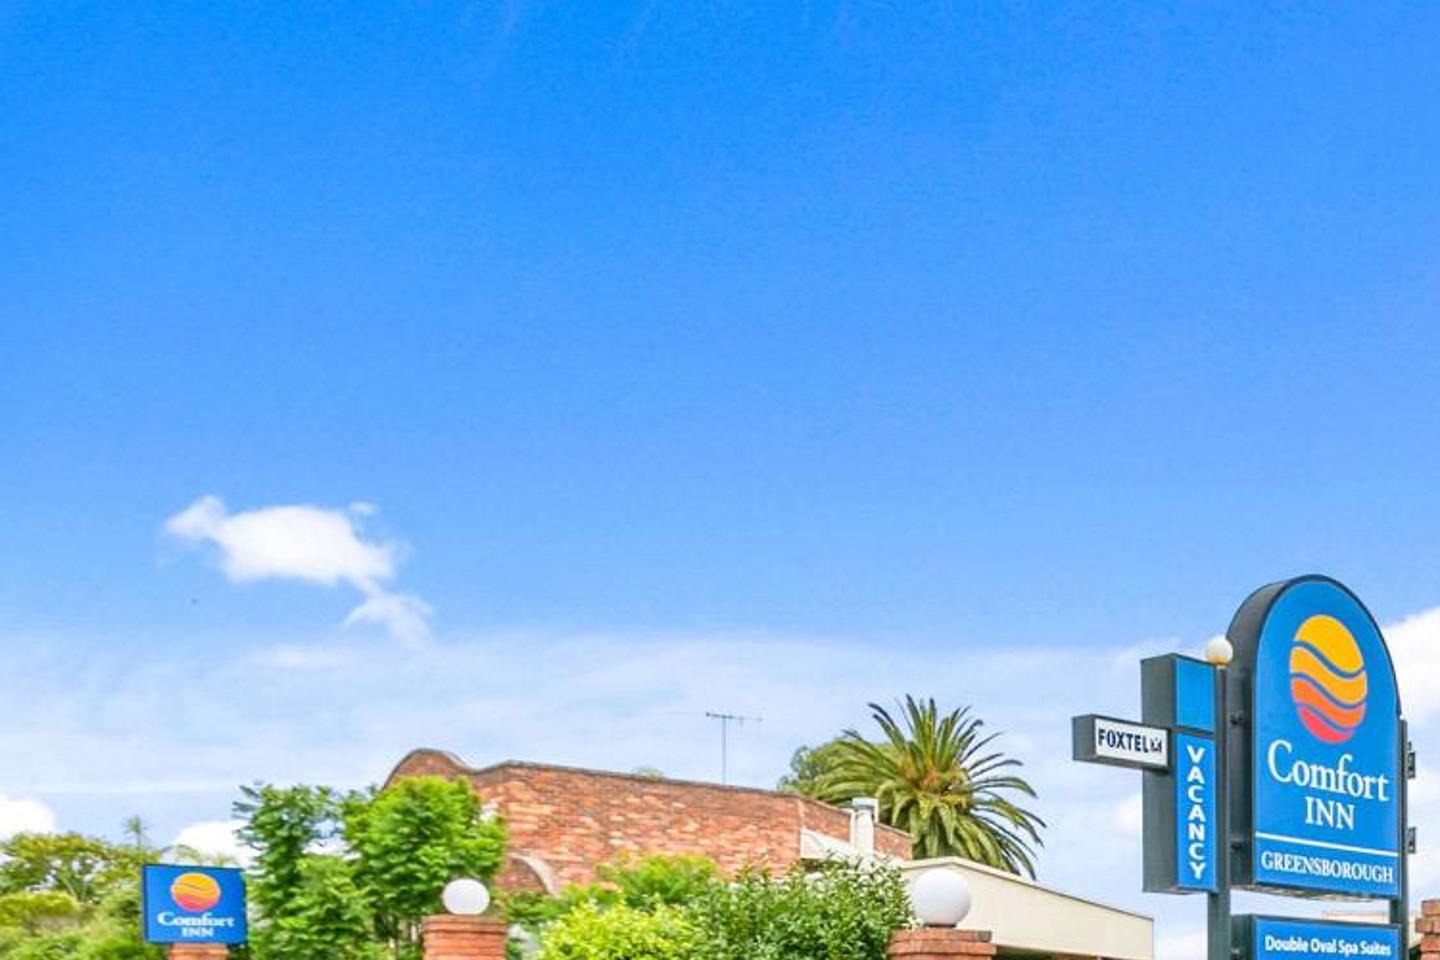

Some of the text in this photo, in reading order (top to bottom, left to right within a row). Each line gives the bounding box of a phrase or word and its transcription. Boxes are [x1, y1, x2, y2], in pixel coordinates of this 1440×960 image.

[1098, 728, 1148, 753] FOXTEL
[1267, 739, 1389, 802] Comfort
[1186, 744, 1206, 880] VACANCY
[1304, 796, 1355, 830] INN
[1261, 851, 1393, 883] GREENSBOROUGH
[157, 911, 235, 927] Comfort
[182, 927, 214, 937] INN
[1264, 935, 1391, 957] Double Oval Spa Suites
